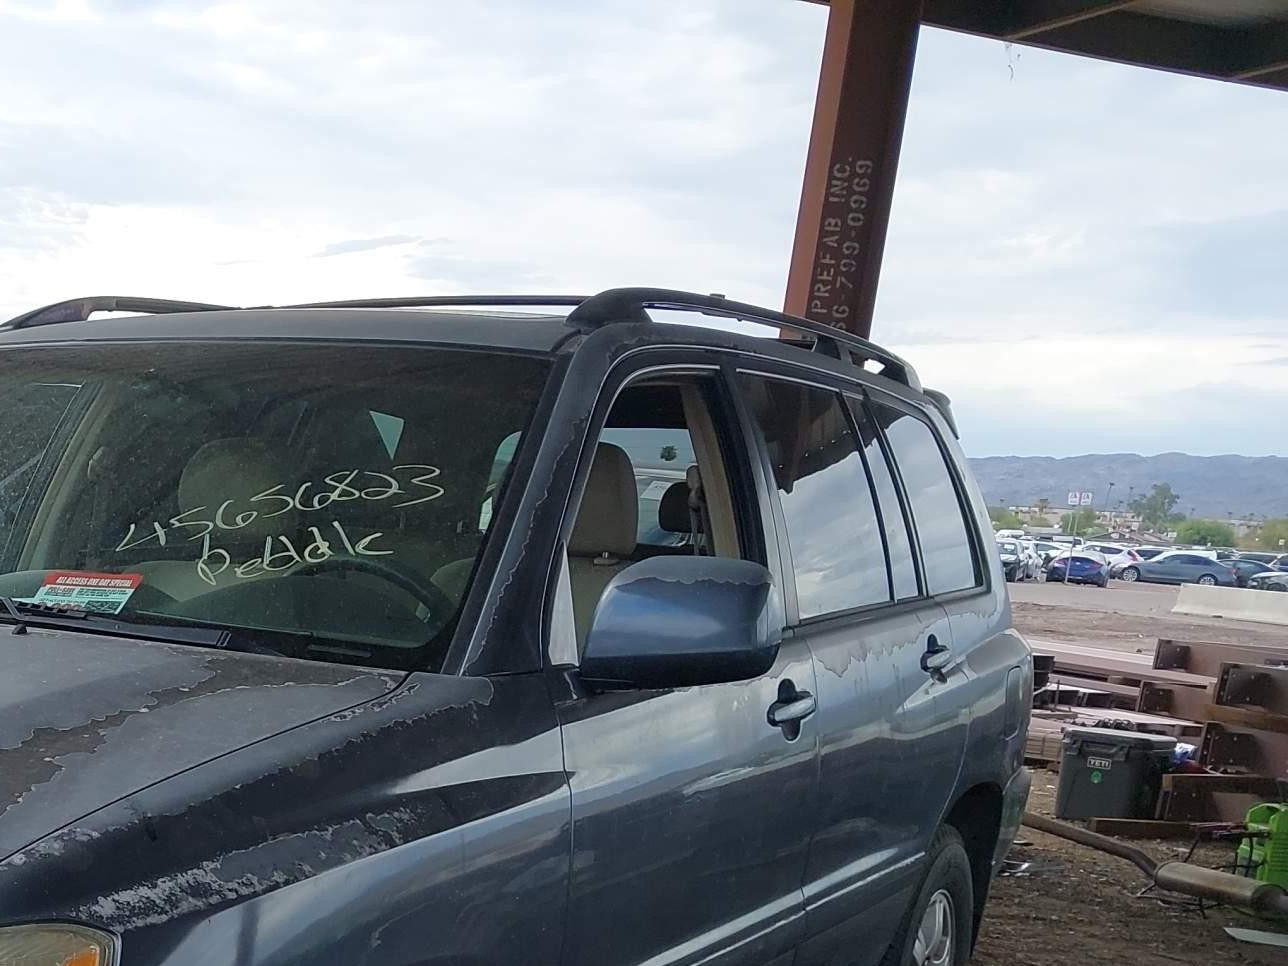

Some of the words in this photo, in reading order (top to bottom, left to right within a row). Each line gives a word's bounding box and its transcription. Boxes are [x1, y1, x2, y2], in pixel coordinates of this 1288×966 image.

[811, 216, 842, 313] PREFAB
[828, 156, 853, 203] INC.
[115, 464, 445, 552] 45656823
